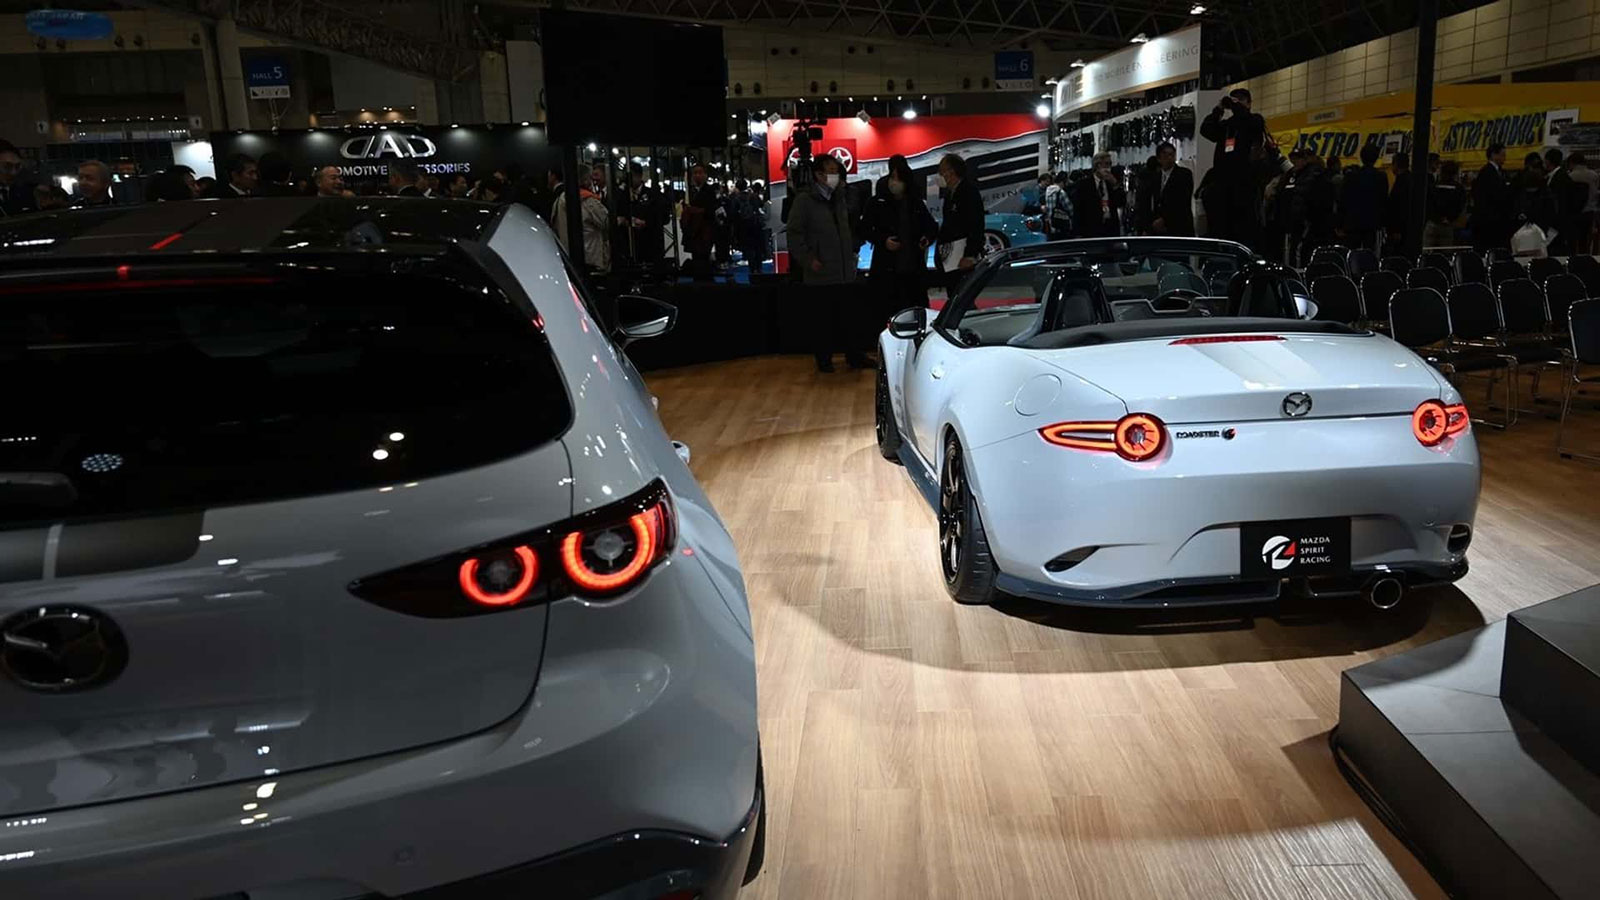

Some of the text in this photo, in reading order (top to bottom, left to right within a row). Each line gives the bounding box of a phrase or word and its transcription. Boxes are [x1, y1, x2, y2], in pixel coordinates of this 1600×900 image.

[1020, 59, 1030, 73] 6
[273, 66, 283, 80] 5
[1443, 121, 1483, 152] ASTRO
[1299, 536, 1330, 545] MAZDA
[1299, 546, 1325, 555] SPIRIT
[1299, 556, 1331, 565] RACING
